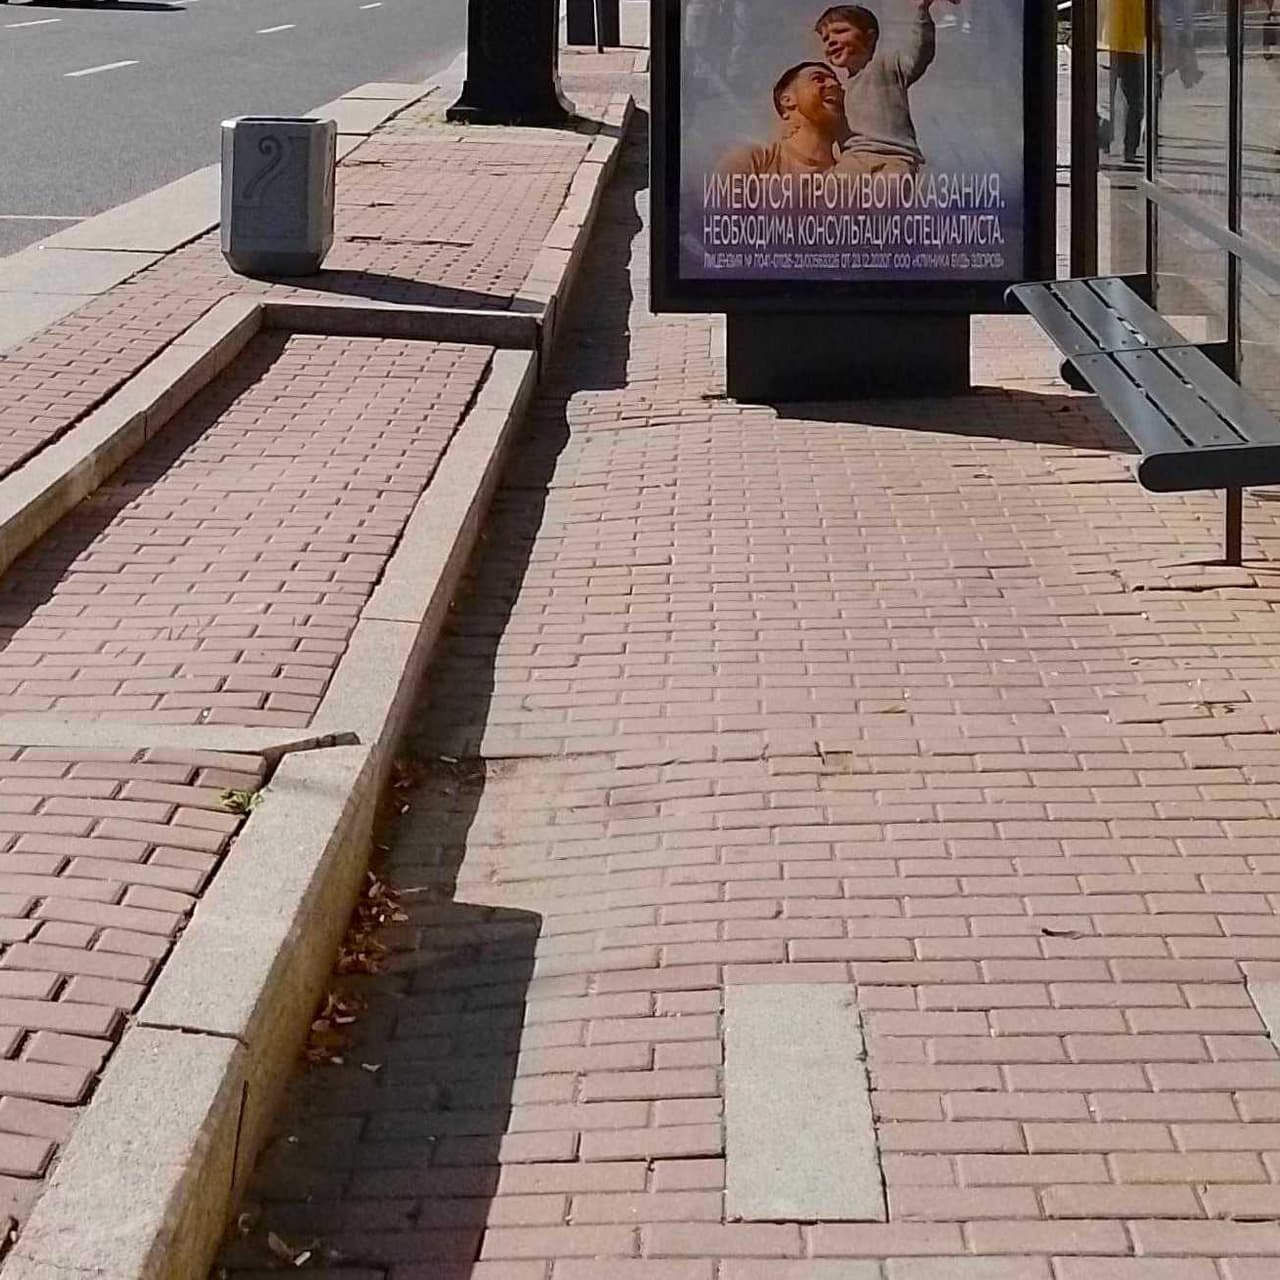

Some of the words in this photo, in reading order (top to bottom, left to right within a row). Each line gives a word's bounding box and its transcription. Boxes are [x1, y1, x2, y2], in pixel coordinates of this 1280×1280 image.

[703, 173, 793, 209] ИМЕЮТСЯ
[799, 173, 1005, 209] ПРОТИВОПОКАЗАНИЯ.
[703, 215, 795, 249] НЕОБХОДИМА
[798, 215, 901, 249] КОНСУЛЬТАЦИЯ
[904, 215, 1005, 249] СПЕЦИАЛИСТА.
